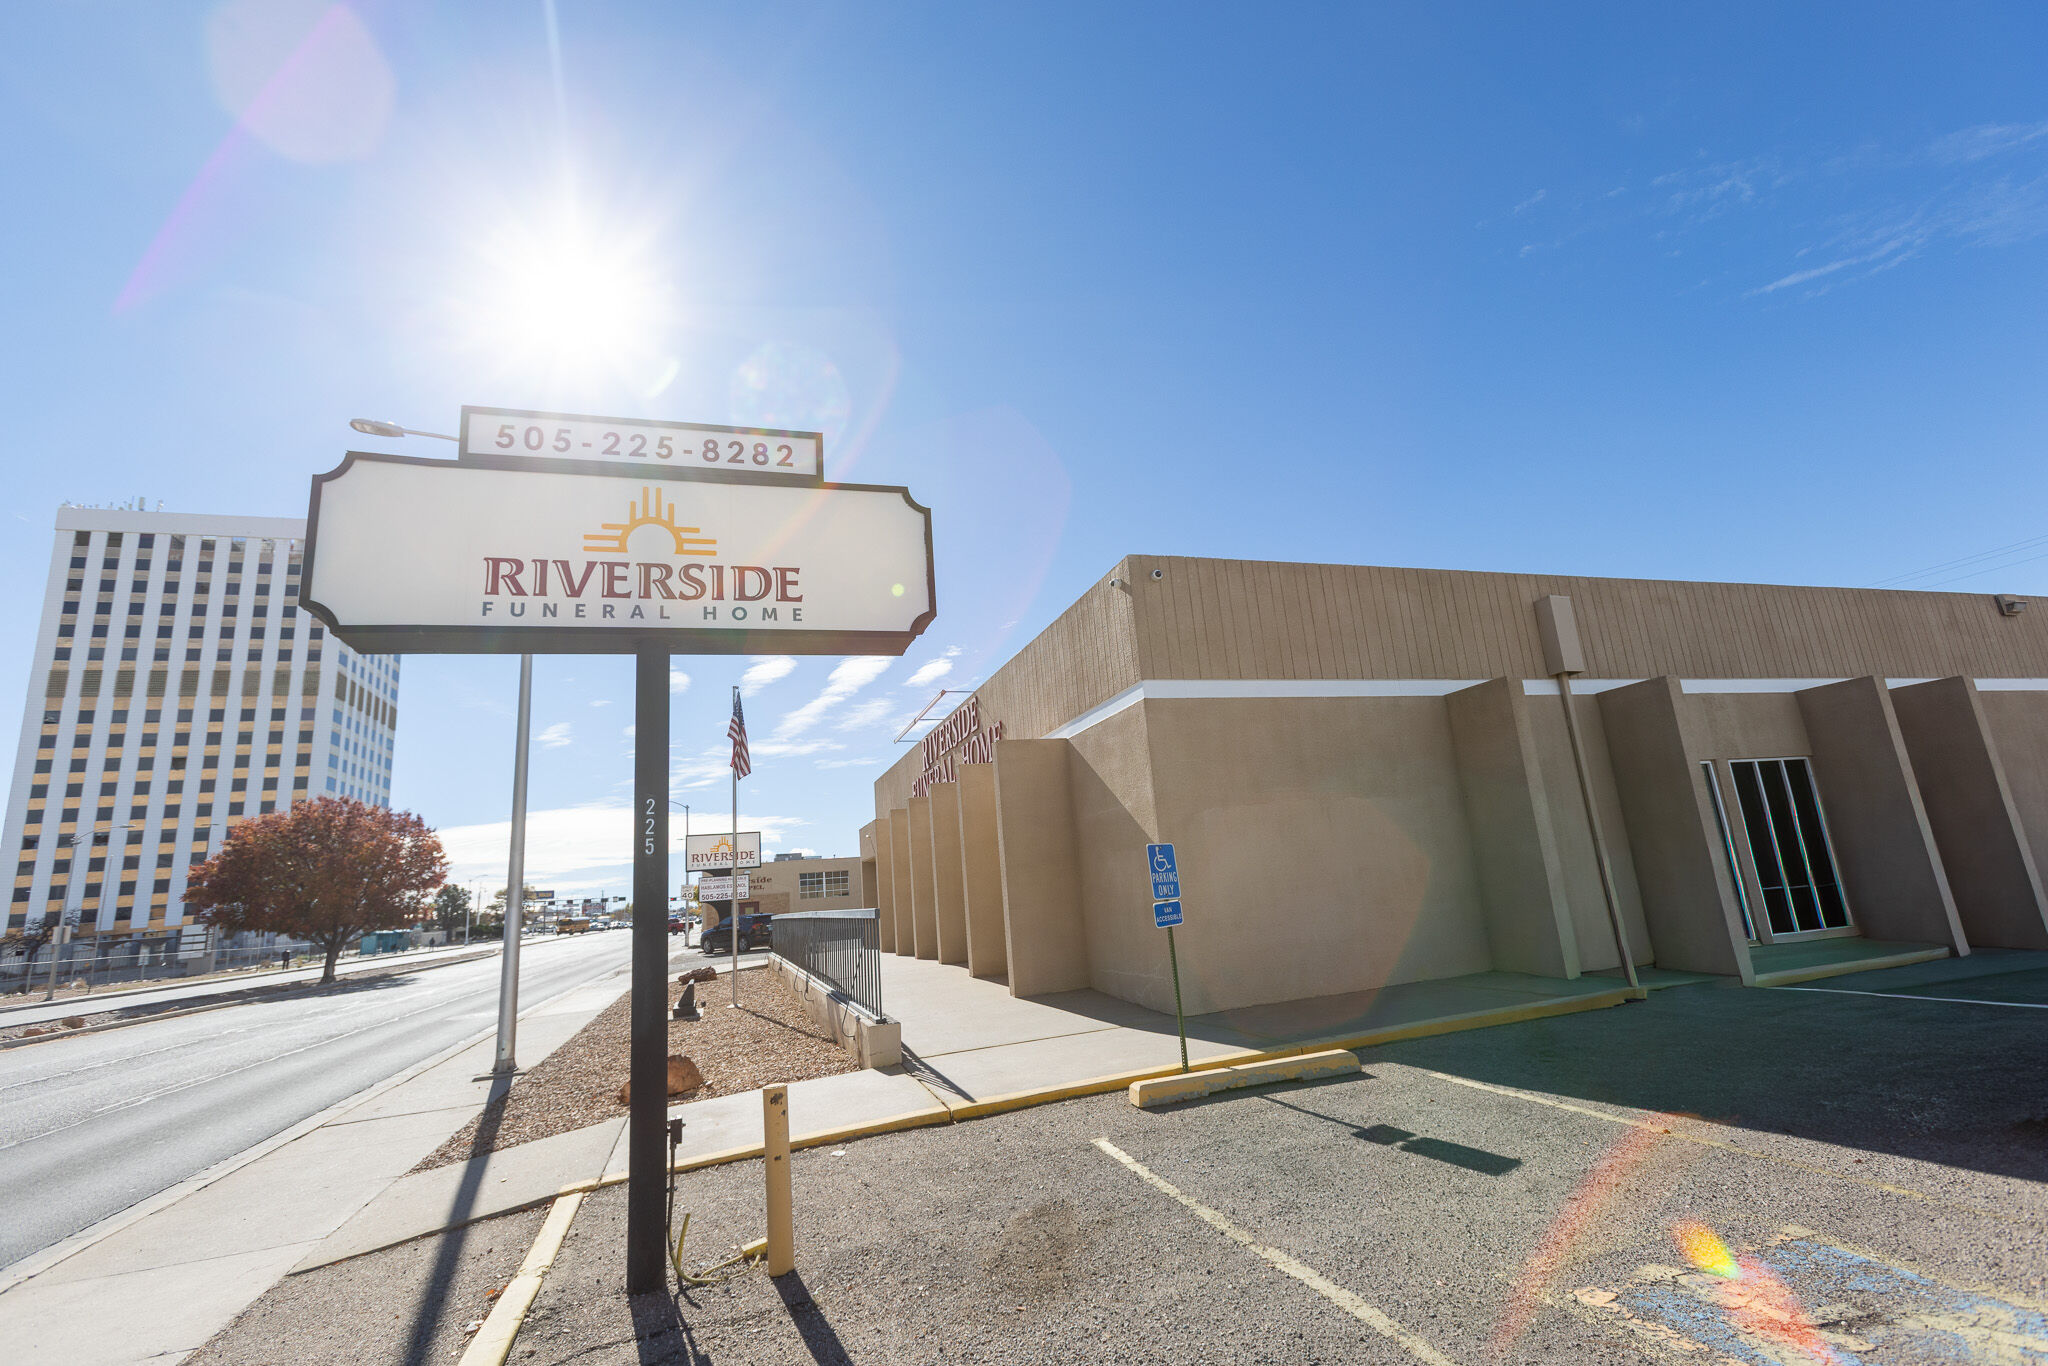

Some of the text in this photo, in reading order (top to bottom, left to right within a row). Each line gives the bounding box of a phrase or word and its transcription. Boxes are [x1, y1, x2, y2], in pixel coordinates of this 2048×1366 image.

[494, 423, 795, 468] 505-225-8282
[483, 556, 804, 603] RIVERSIDE
[482, 601, 804, 622] FUNERAL HOME
[921, 695, 980, 772] RIVERSIDE
[645, 798, 656, 855] 225
[1152, 871, 1178, 883] PARKING
[1158, 885, 1174, 896] ONLY
[701, 891, 747, 901] 505-225-82
